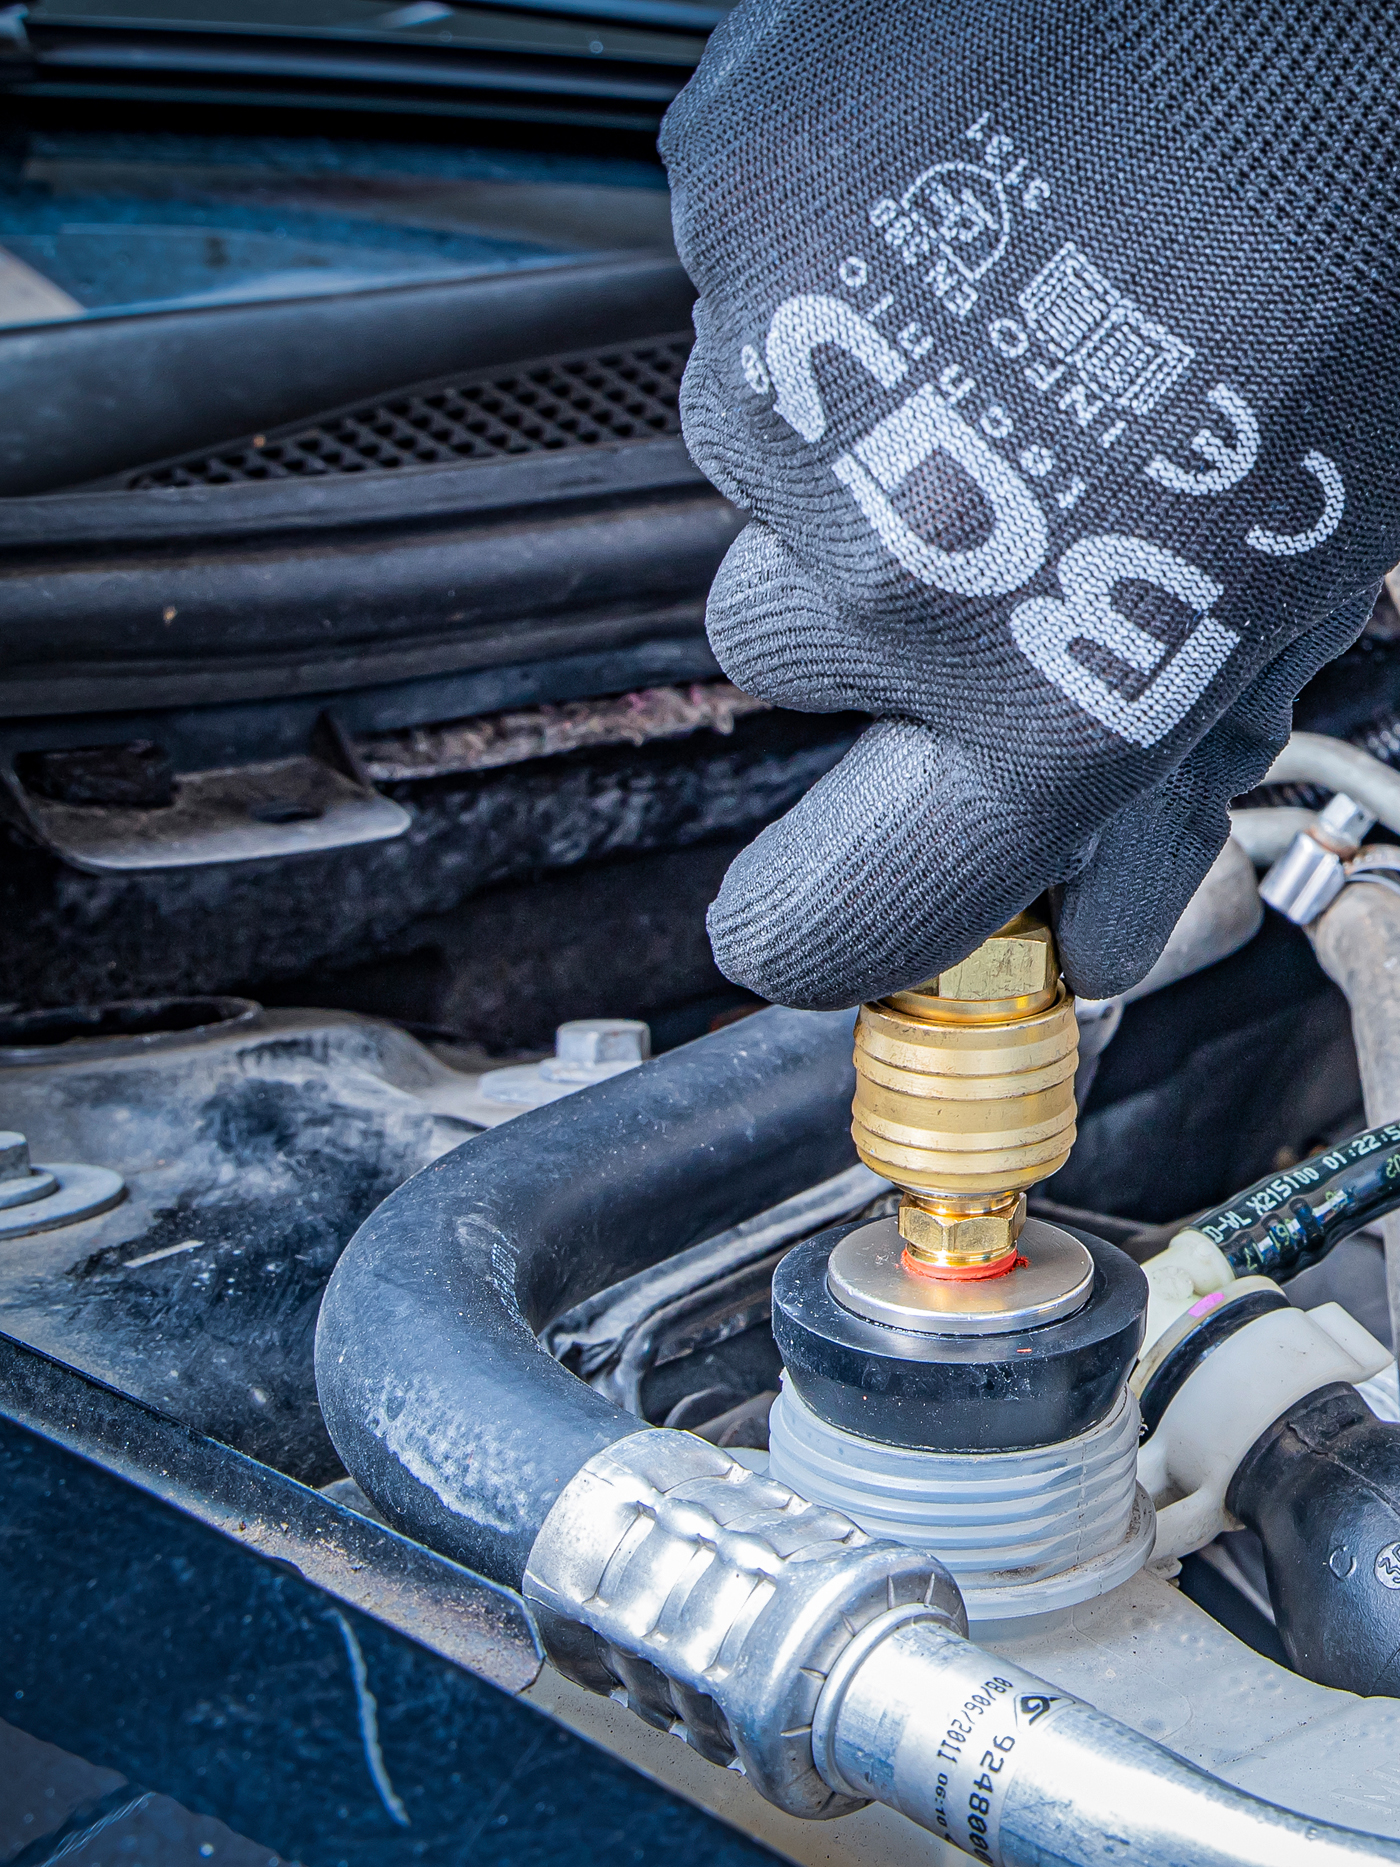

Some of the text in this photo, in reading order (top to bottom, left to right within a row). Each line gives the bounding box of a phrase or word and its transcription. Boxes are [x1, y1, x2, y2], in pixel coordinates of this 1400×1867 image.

[839, 256, 1087, 508] technic
[991, 316, 1126, 448] INFO
[1147, 384, 1345, 556] CE
[937, 1676, 1014, 1764] 08/06/2011
